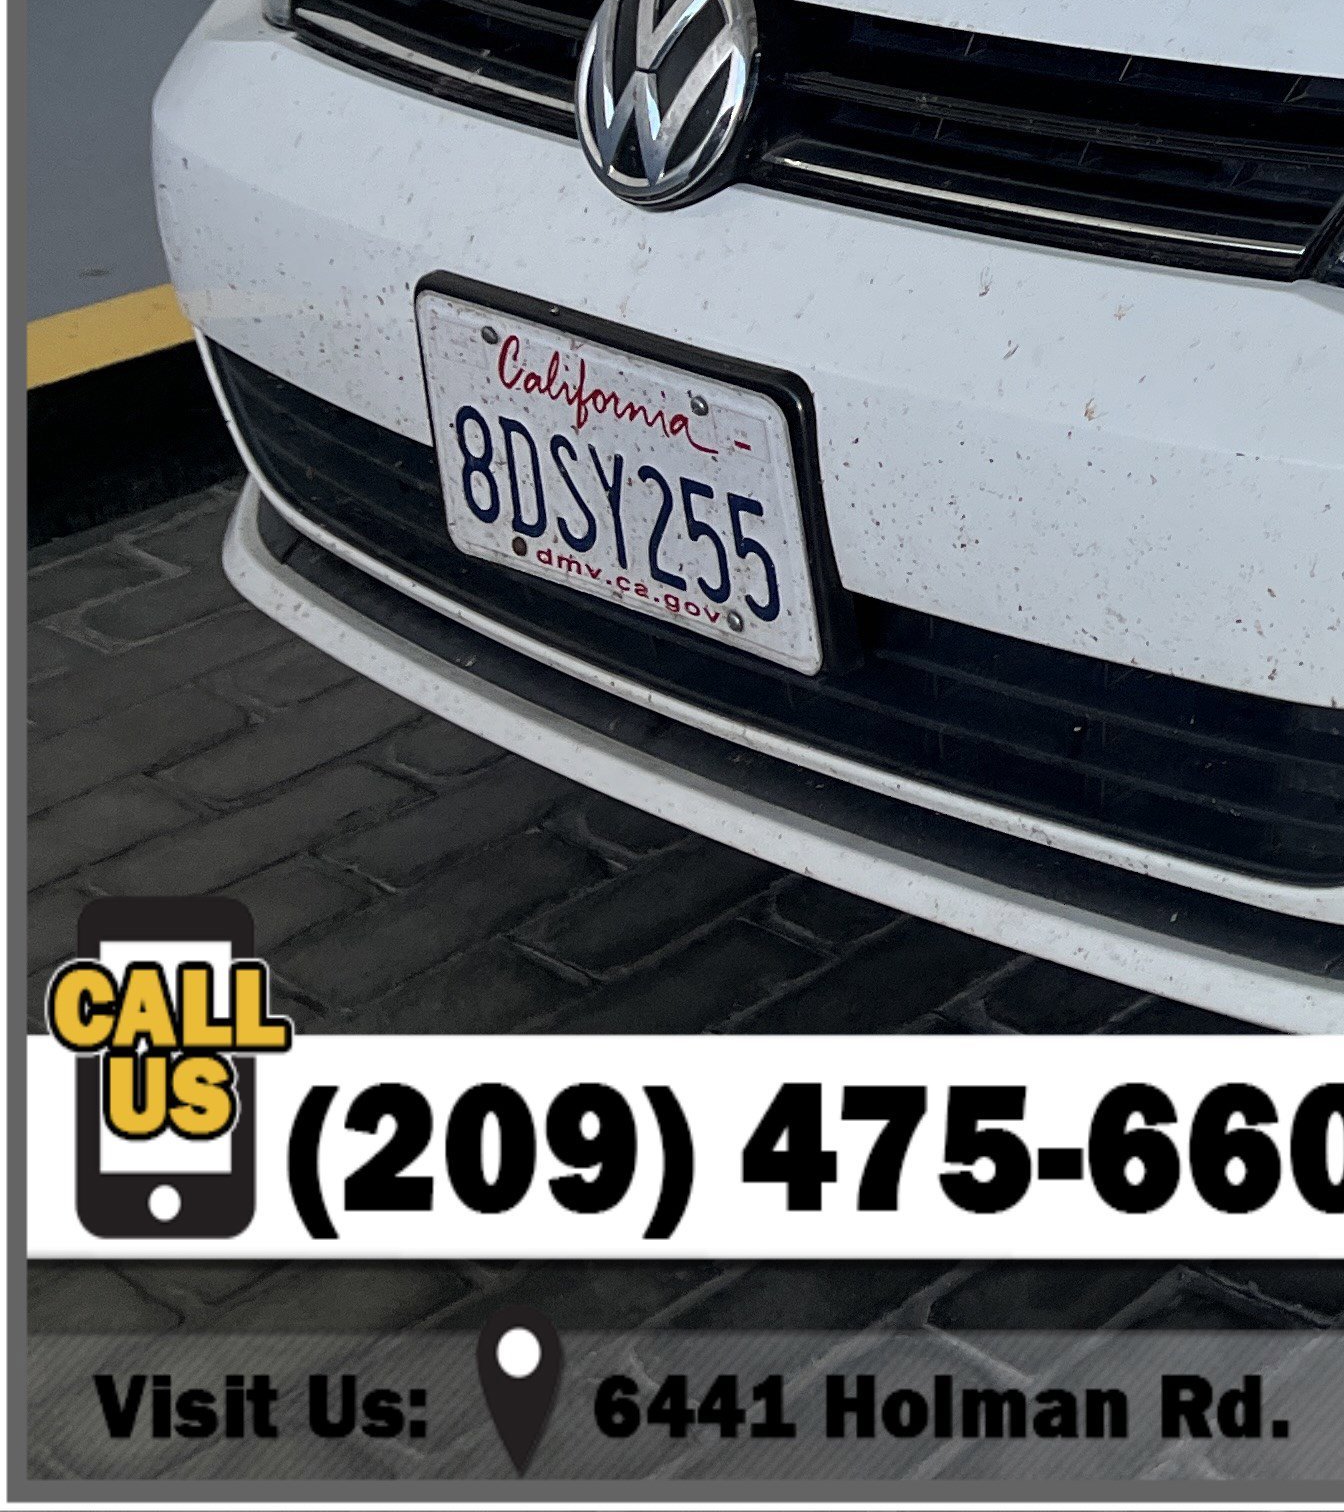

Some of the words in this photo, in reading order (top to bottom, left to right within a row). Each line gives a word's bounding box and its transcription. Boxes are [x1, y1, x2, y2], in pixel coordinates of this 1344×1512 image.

[498, 335, 719, 454] California
[455, 404, 780, 622] 8DSY255
[535, 547, 721, 625] dmv.ca.gov
